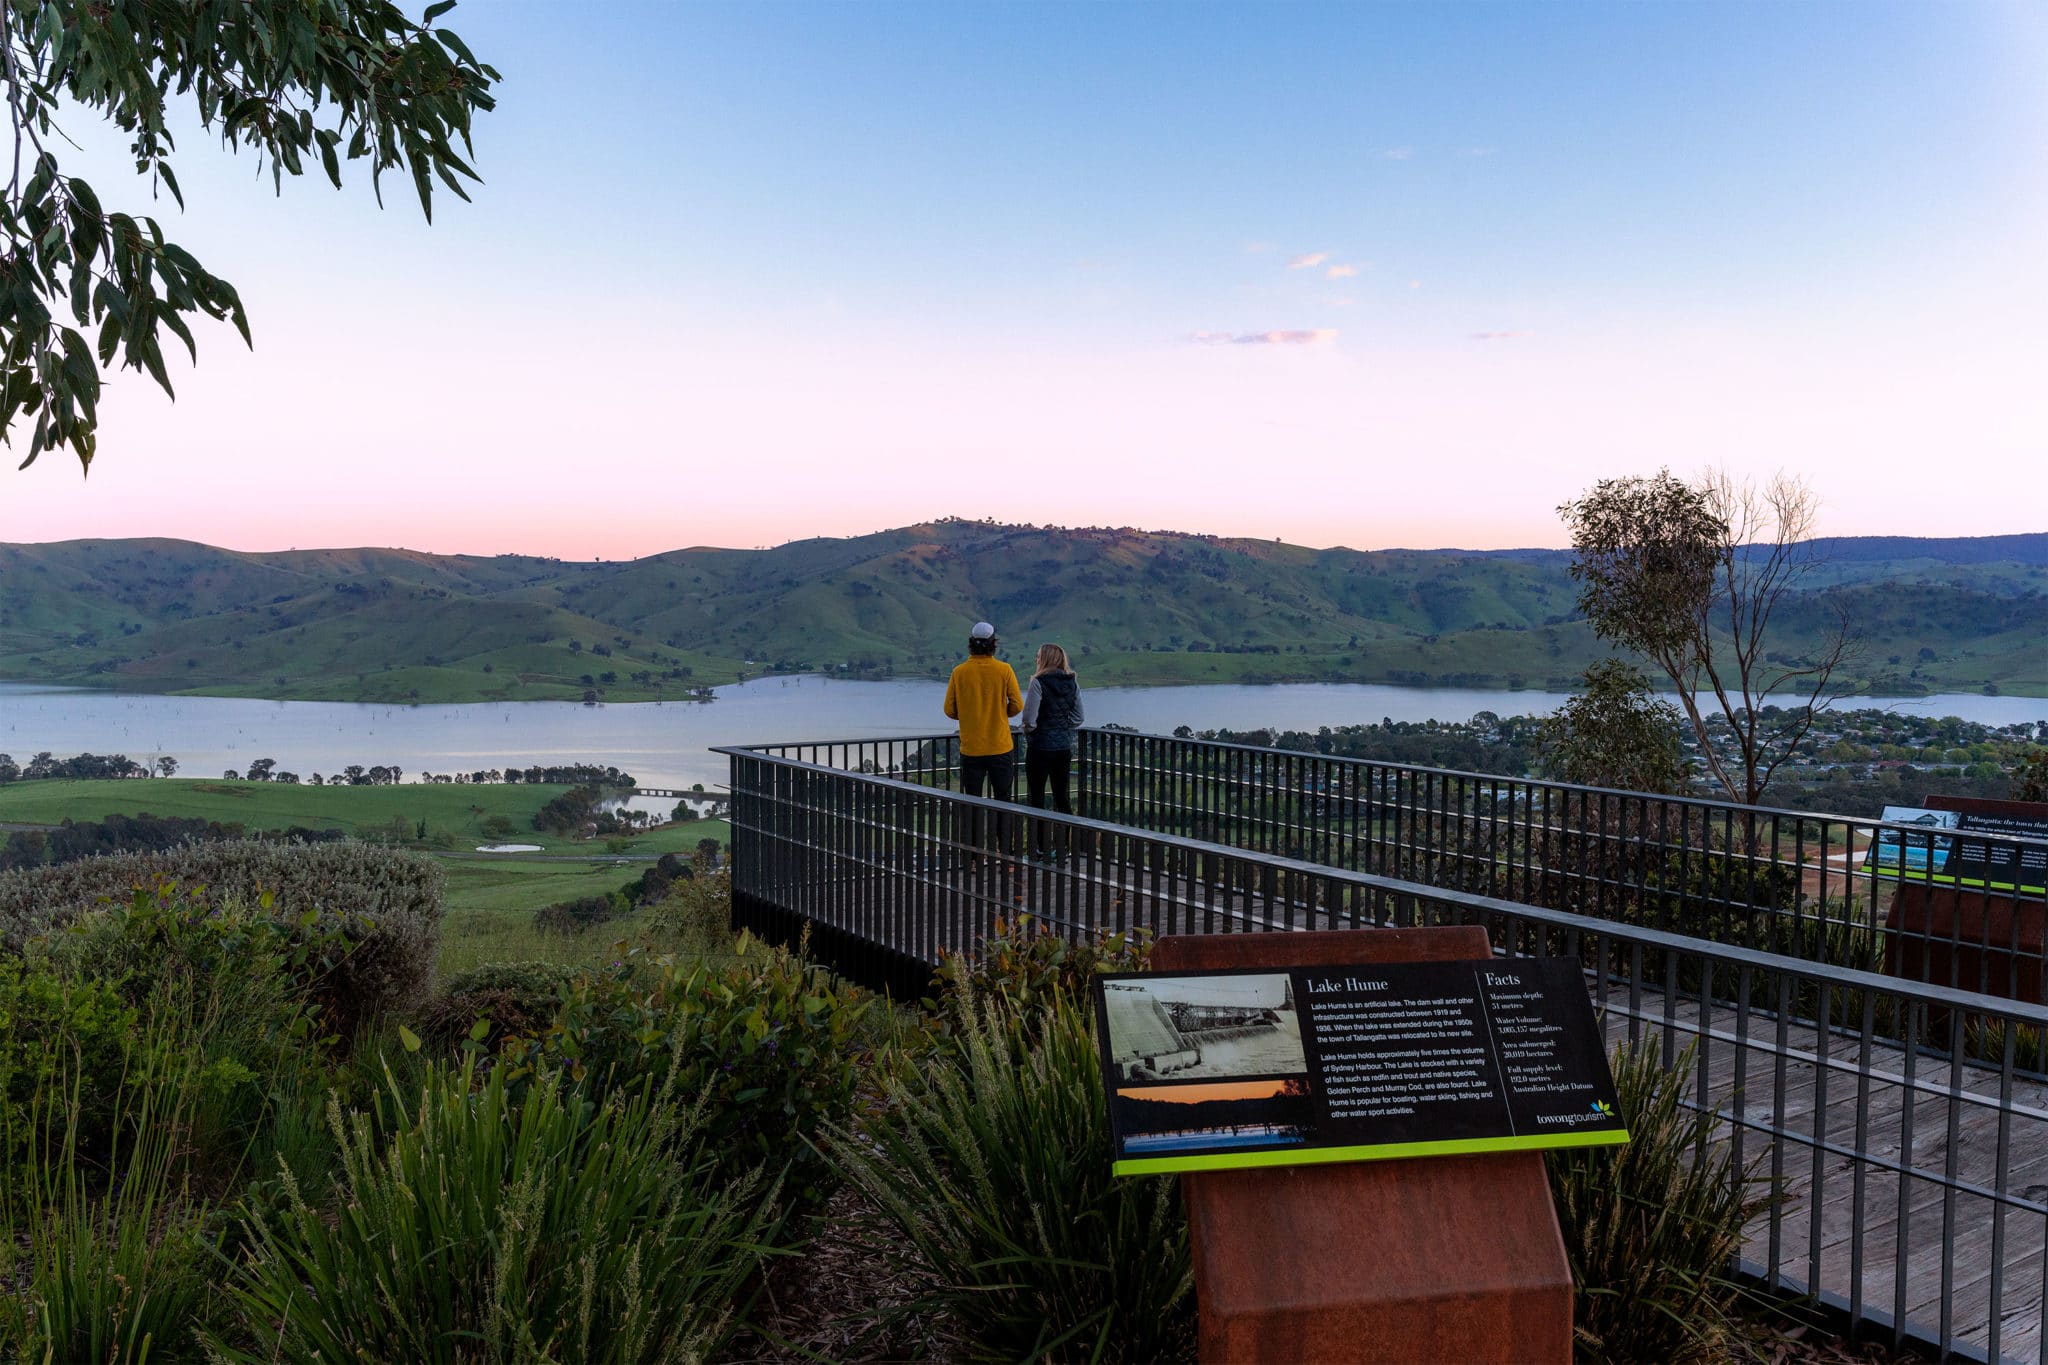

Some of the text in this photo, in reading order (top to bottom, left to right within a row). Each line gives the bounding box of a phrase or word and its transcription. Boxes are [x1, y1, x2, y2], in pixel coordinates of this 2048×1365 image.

[1485, 973, 1520, 986] Facts
[1307, 978, 1389, 993] Lake Hume
[1523, 992, 1544, 1000] depth:
[1530, 1025, 1563, 1033] megalitres
[1519, 1040, 1556, 1048] submerged:
[1377, 1050, 1419, 1059] approximately
[1331, 1064, 1354, 1073] Sydney
[1523, 1065, 1544, 1074] supply
[1548, 1084, 1569, 1092] Height
[1357, 1097, 1381, 1105] popular
[1537, 1112, 1606, 1125] towongtourism
